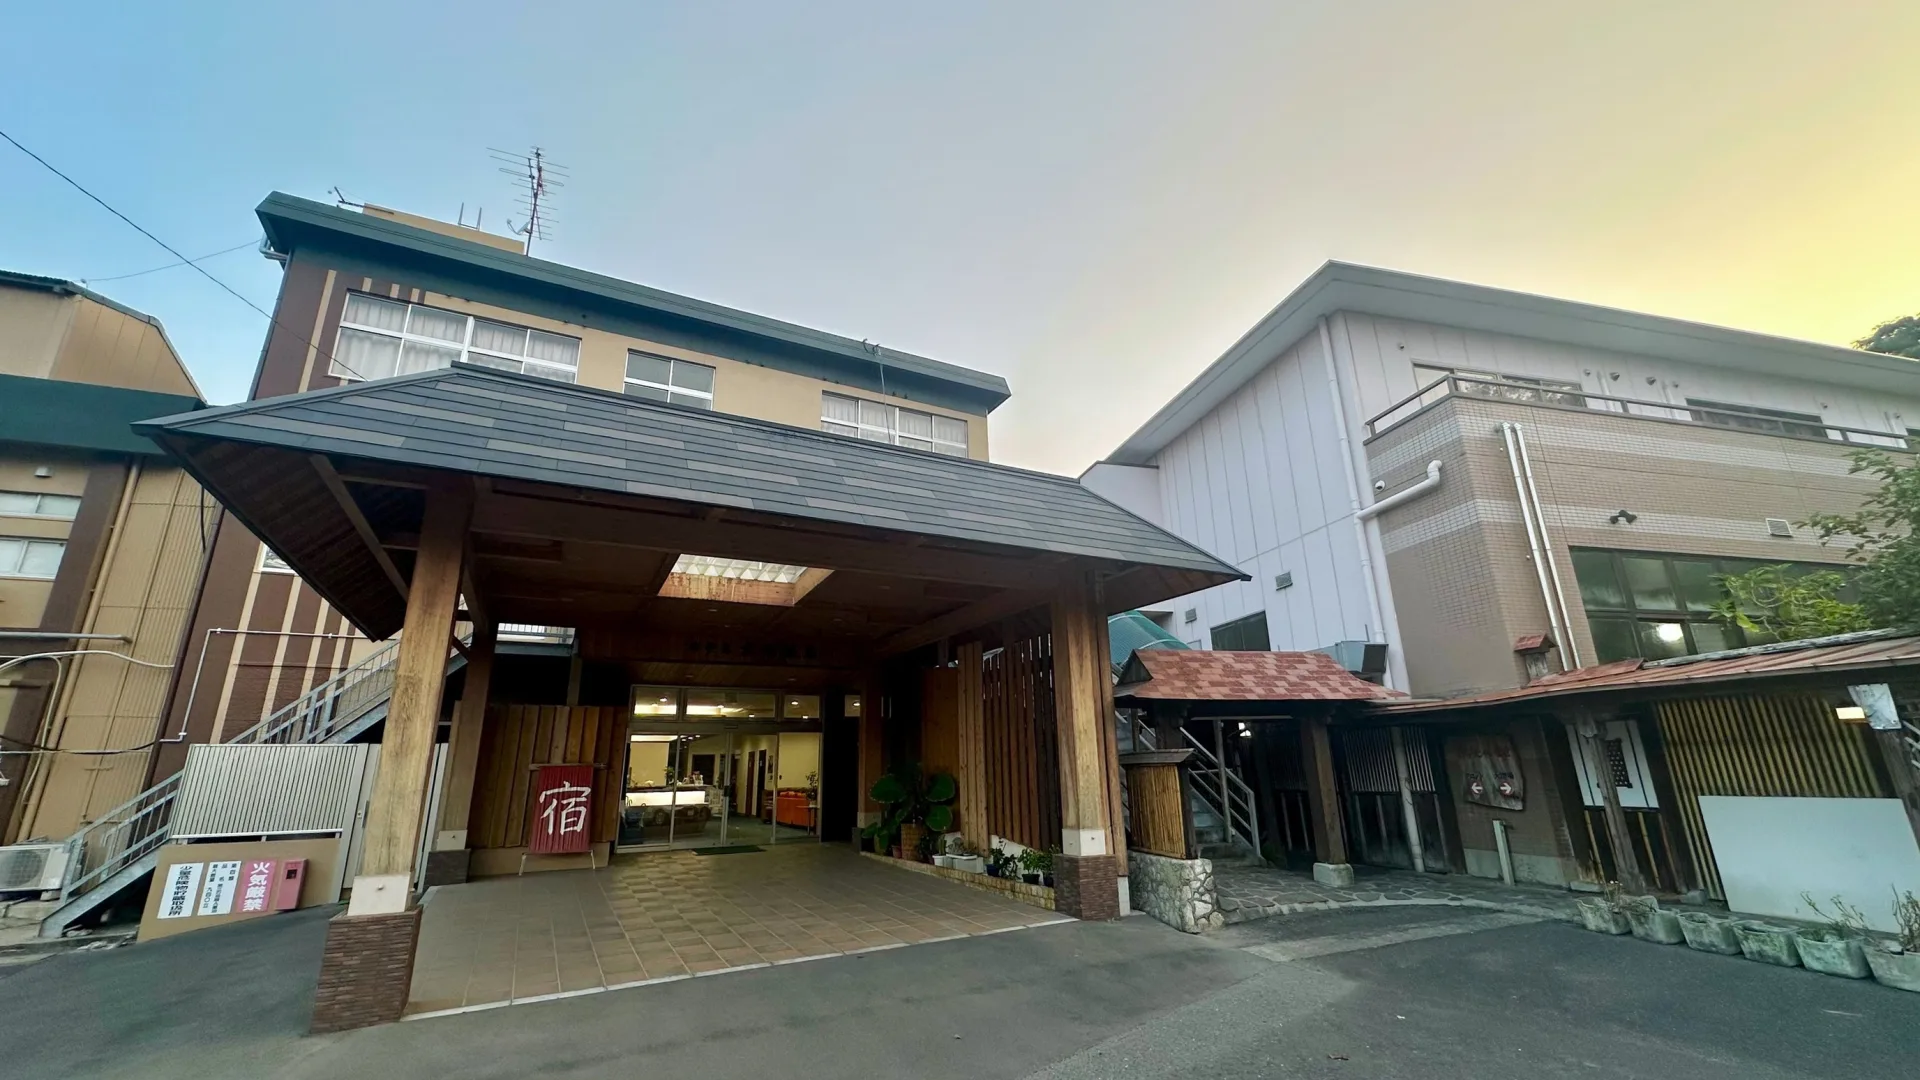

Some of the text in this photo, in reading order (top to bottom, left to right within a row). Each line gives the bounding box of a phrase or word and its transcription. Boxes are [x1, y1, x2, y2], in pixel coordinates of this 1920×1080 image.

[539, 780, 592, 836] 宿
[168, 865, 193, 916] 少量危険物貯蔵取扱所
[242, 861, 271, 912] 火気厳禁
